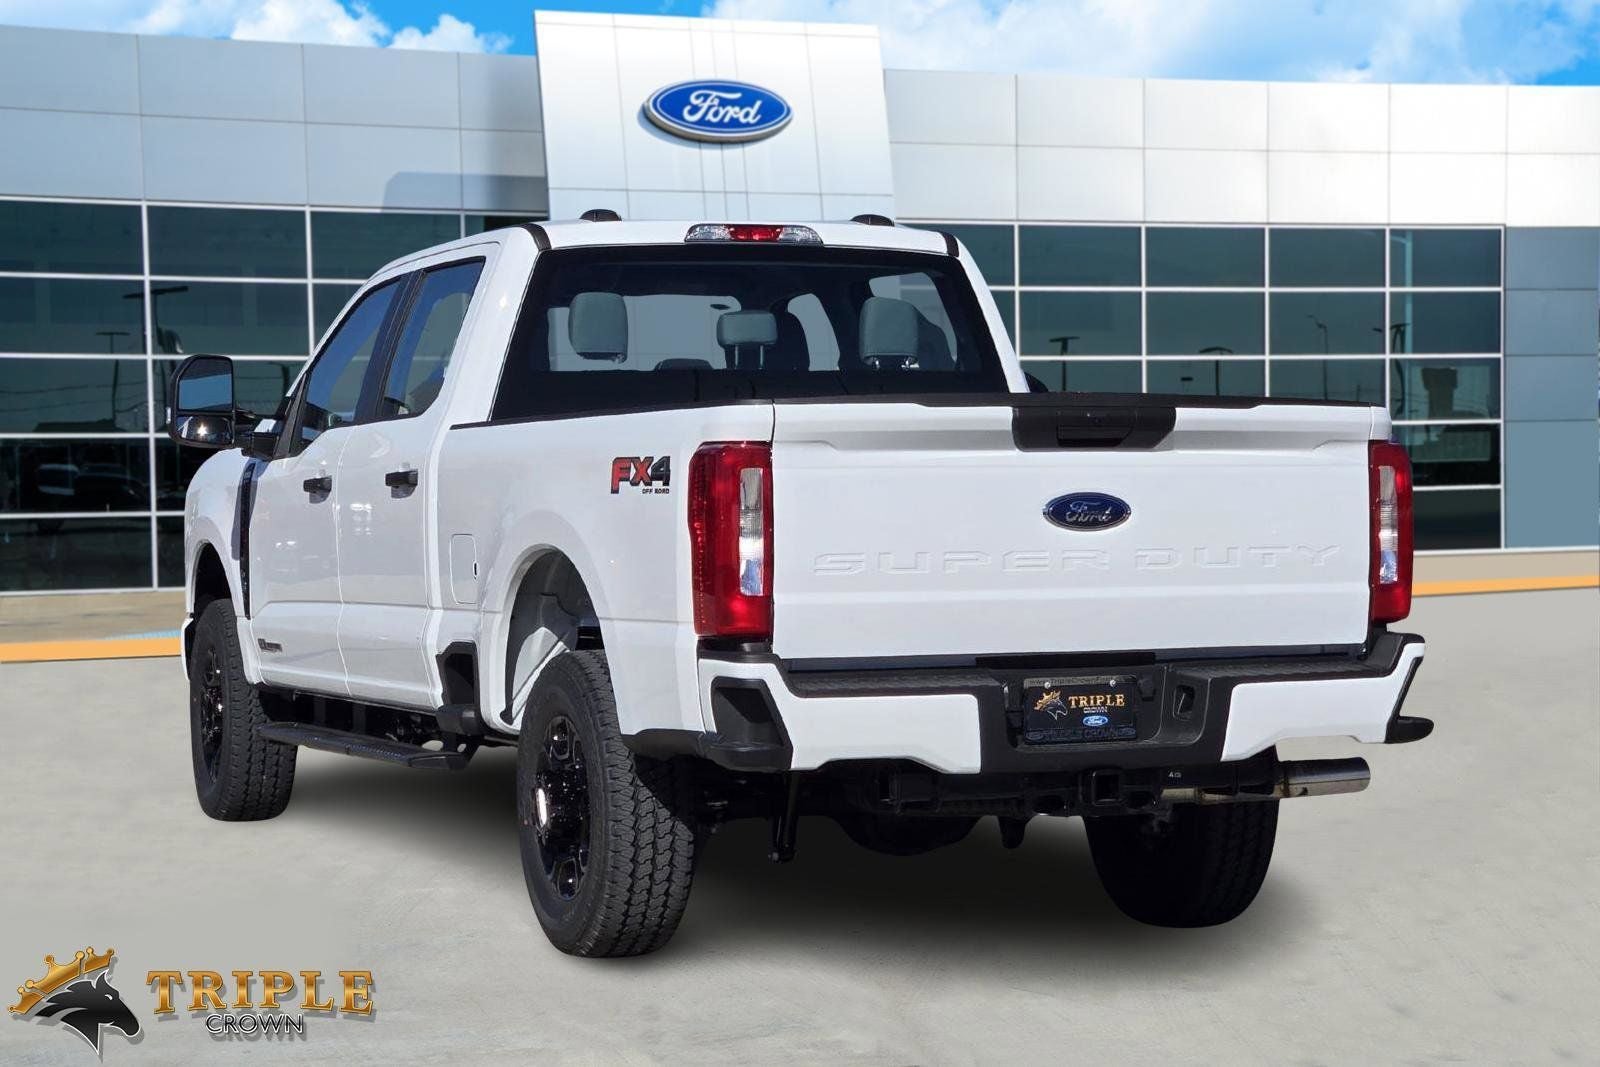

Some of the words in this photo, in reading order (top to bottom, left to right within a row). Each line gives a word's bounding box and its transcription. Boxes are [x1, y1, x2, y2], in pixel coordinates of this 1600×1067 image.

[682, 90, 762, 124] Ford
[611, 456, 671, 494] FX4
[1065, 501, 1112, 522] Ford
[813, 549, 1111, 576] SUPER
[1134, 545, 1341, 570] DUTY
[1068, 694, 1125, 708] TRIPLE
